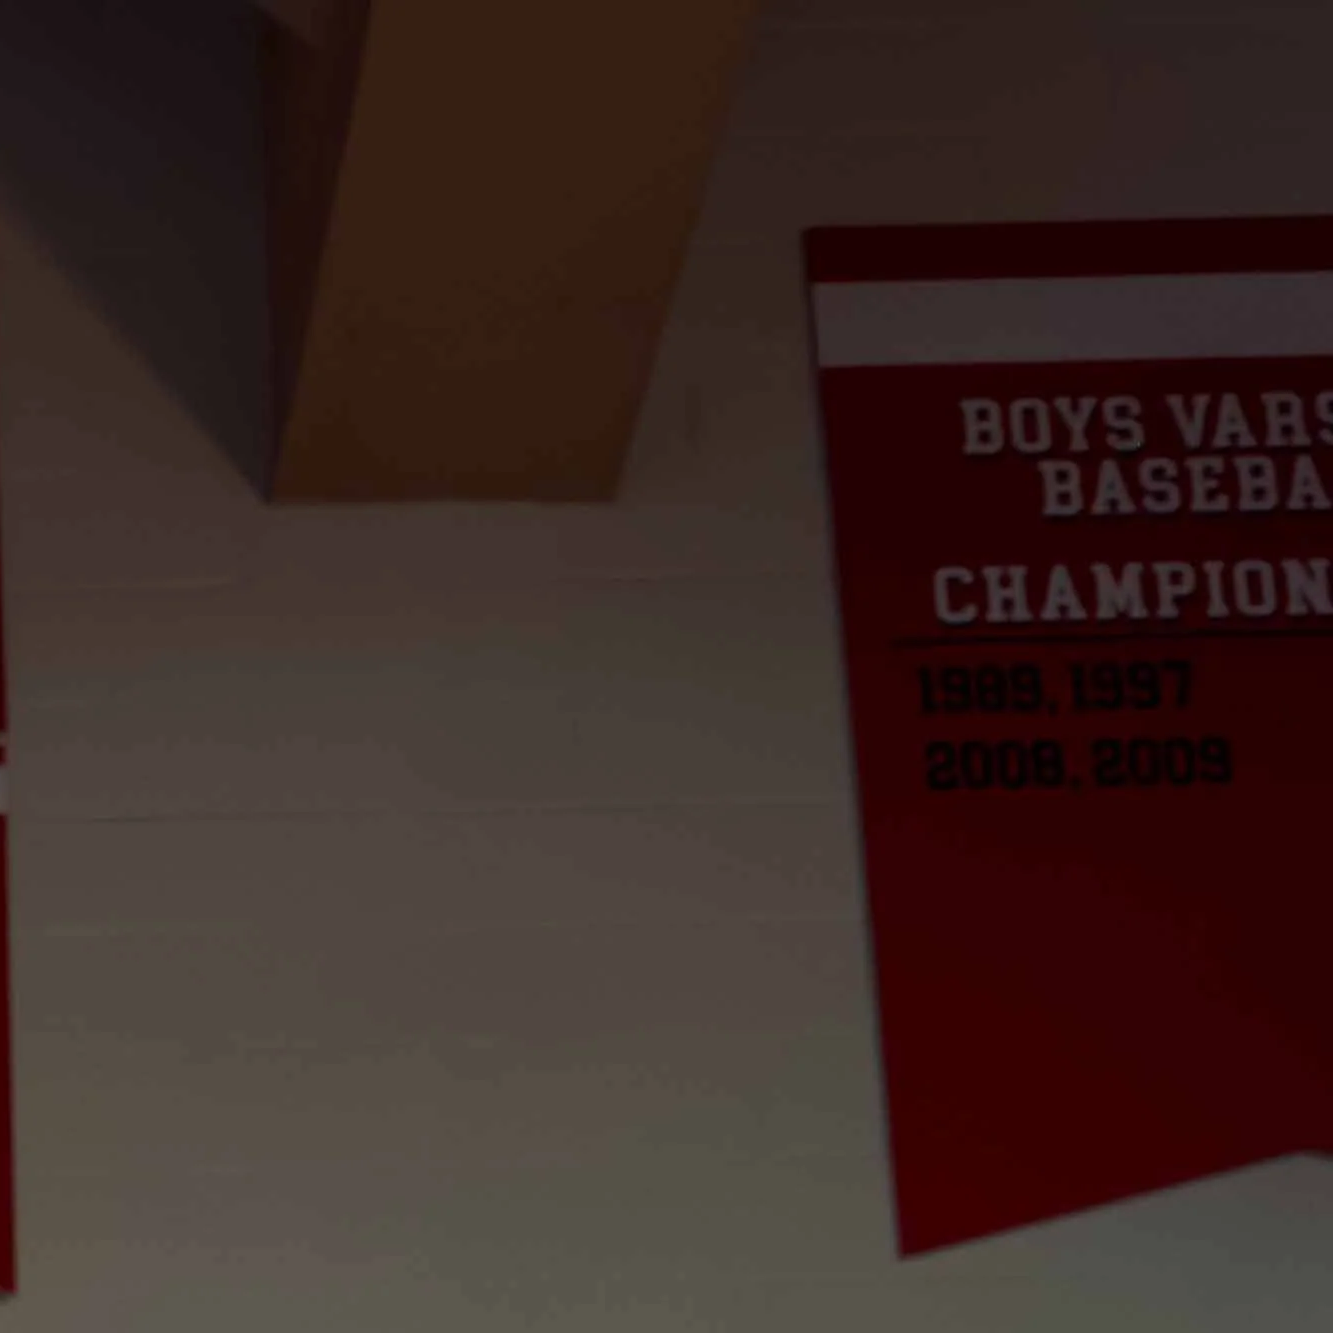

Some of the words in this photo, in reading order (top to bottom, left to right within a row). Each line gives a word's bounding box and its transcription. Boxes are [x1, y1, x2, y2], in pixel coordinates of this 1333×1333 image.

[959, 395, 1146, 456] BOYS
[1037, 454, 1332, 518] BASEBA
[933, 557, 1333, 625] CHAMPION
[1071, 660, 1193, 712] 1997
[1091, 737, 1234, 788] 2009
